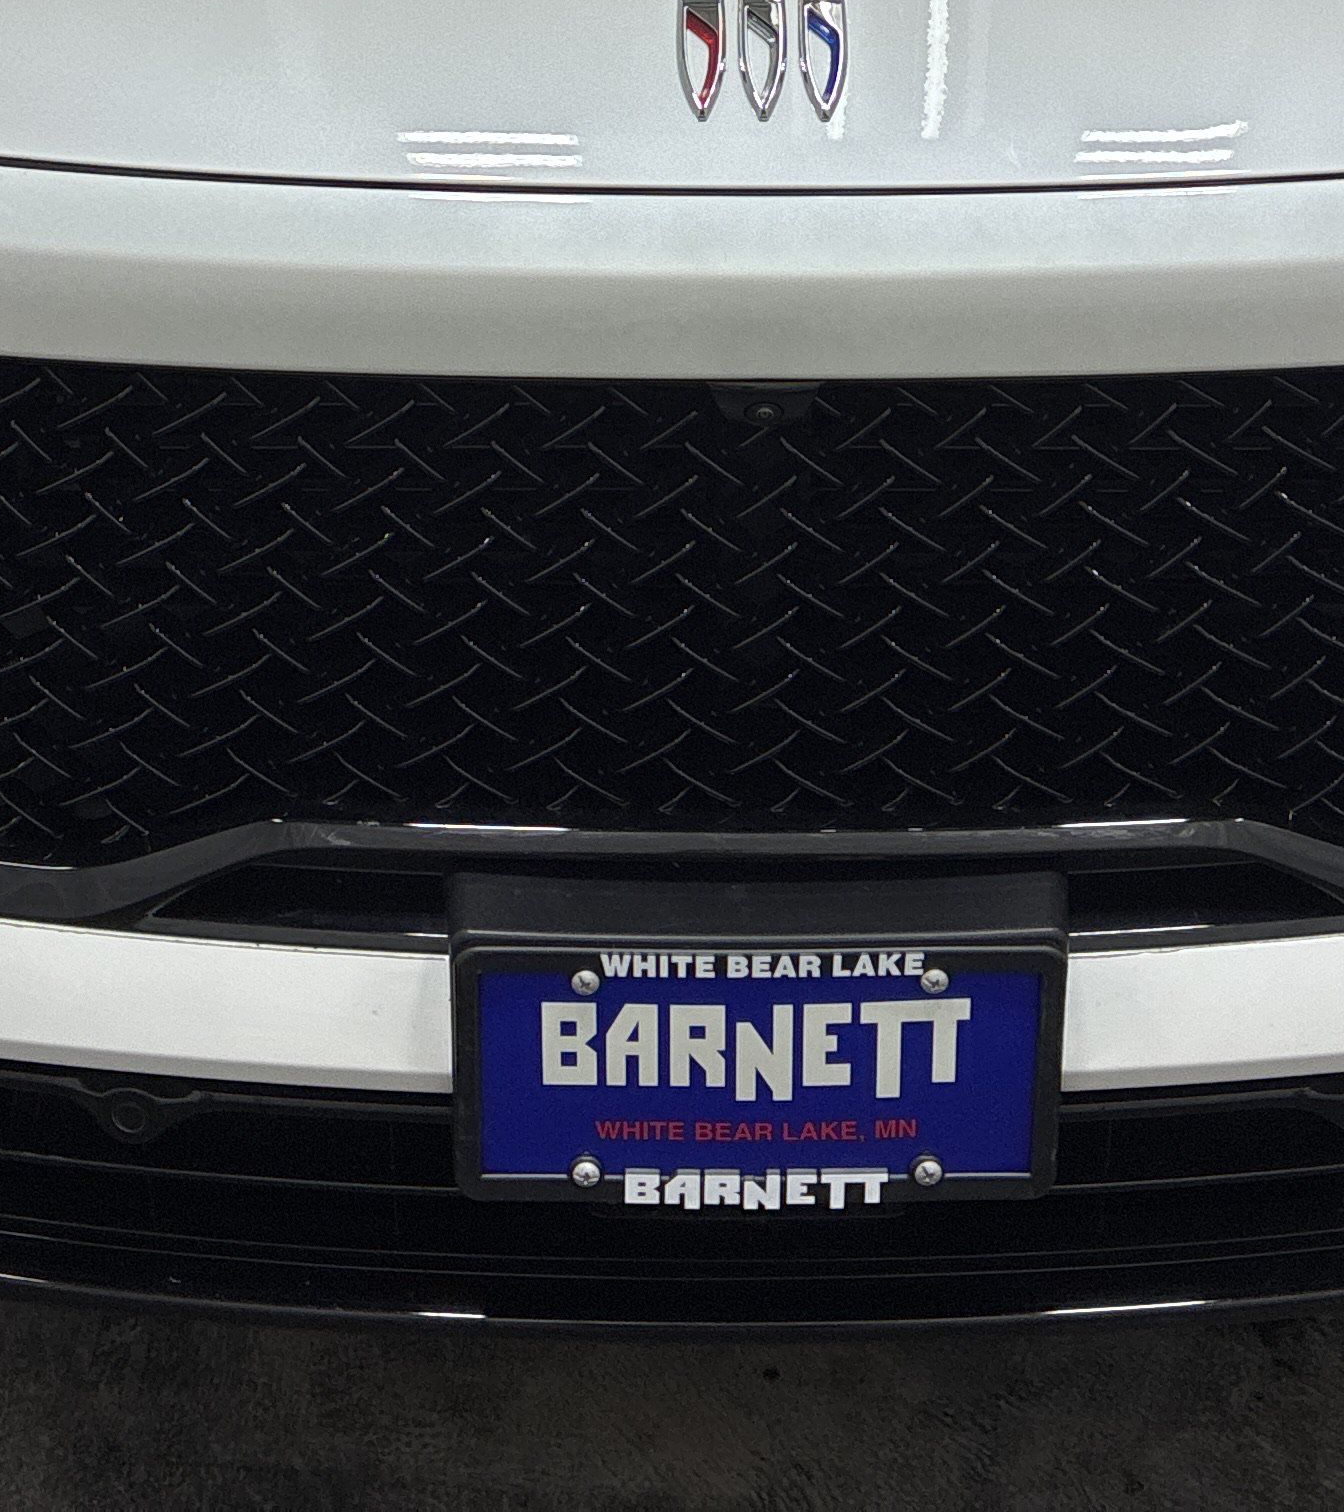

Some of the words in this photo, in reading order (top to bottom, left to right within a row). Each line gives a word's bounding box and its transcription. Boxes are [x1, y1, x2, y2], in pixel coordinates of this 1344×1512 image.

[600, 953, 716, 979] WHITE
[726, 953, 821, 979] BEAR
[831, 951, 926, 977] LAKE
[540, 997, 972, 1102] BARNETT
[594, 1119, 685, 1142] WHITE
[694, 1120, 773, 1143] BEAR
[782, 1119, 866, 1144] LAKE,
[874, 1118, 918, 1140] MN
[623, 1167, 889, 1211] BARNETT
